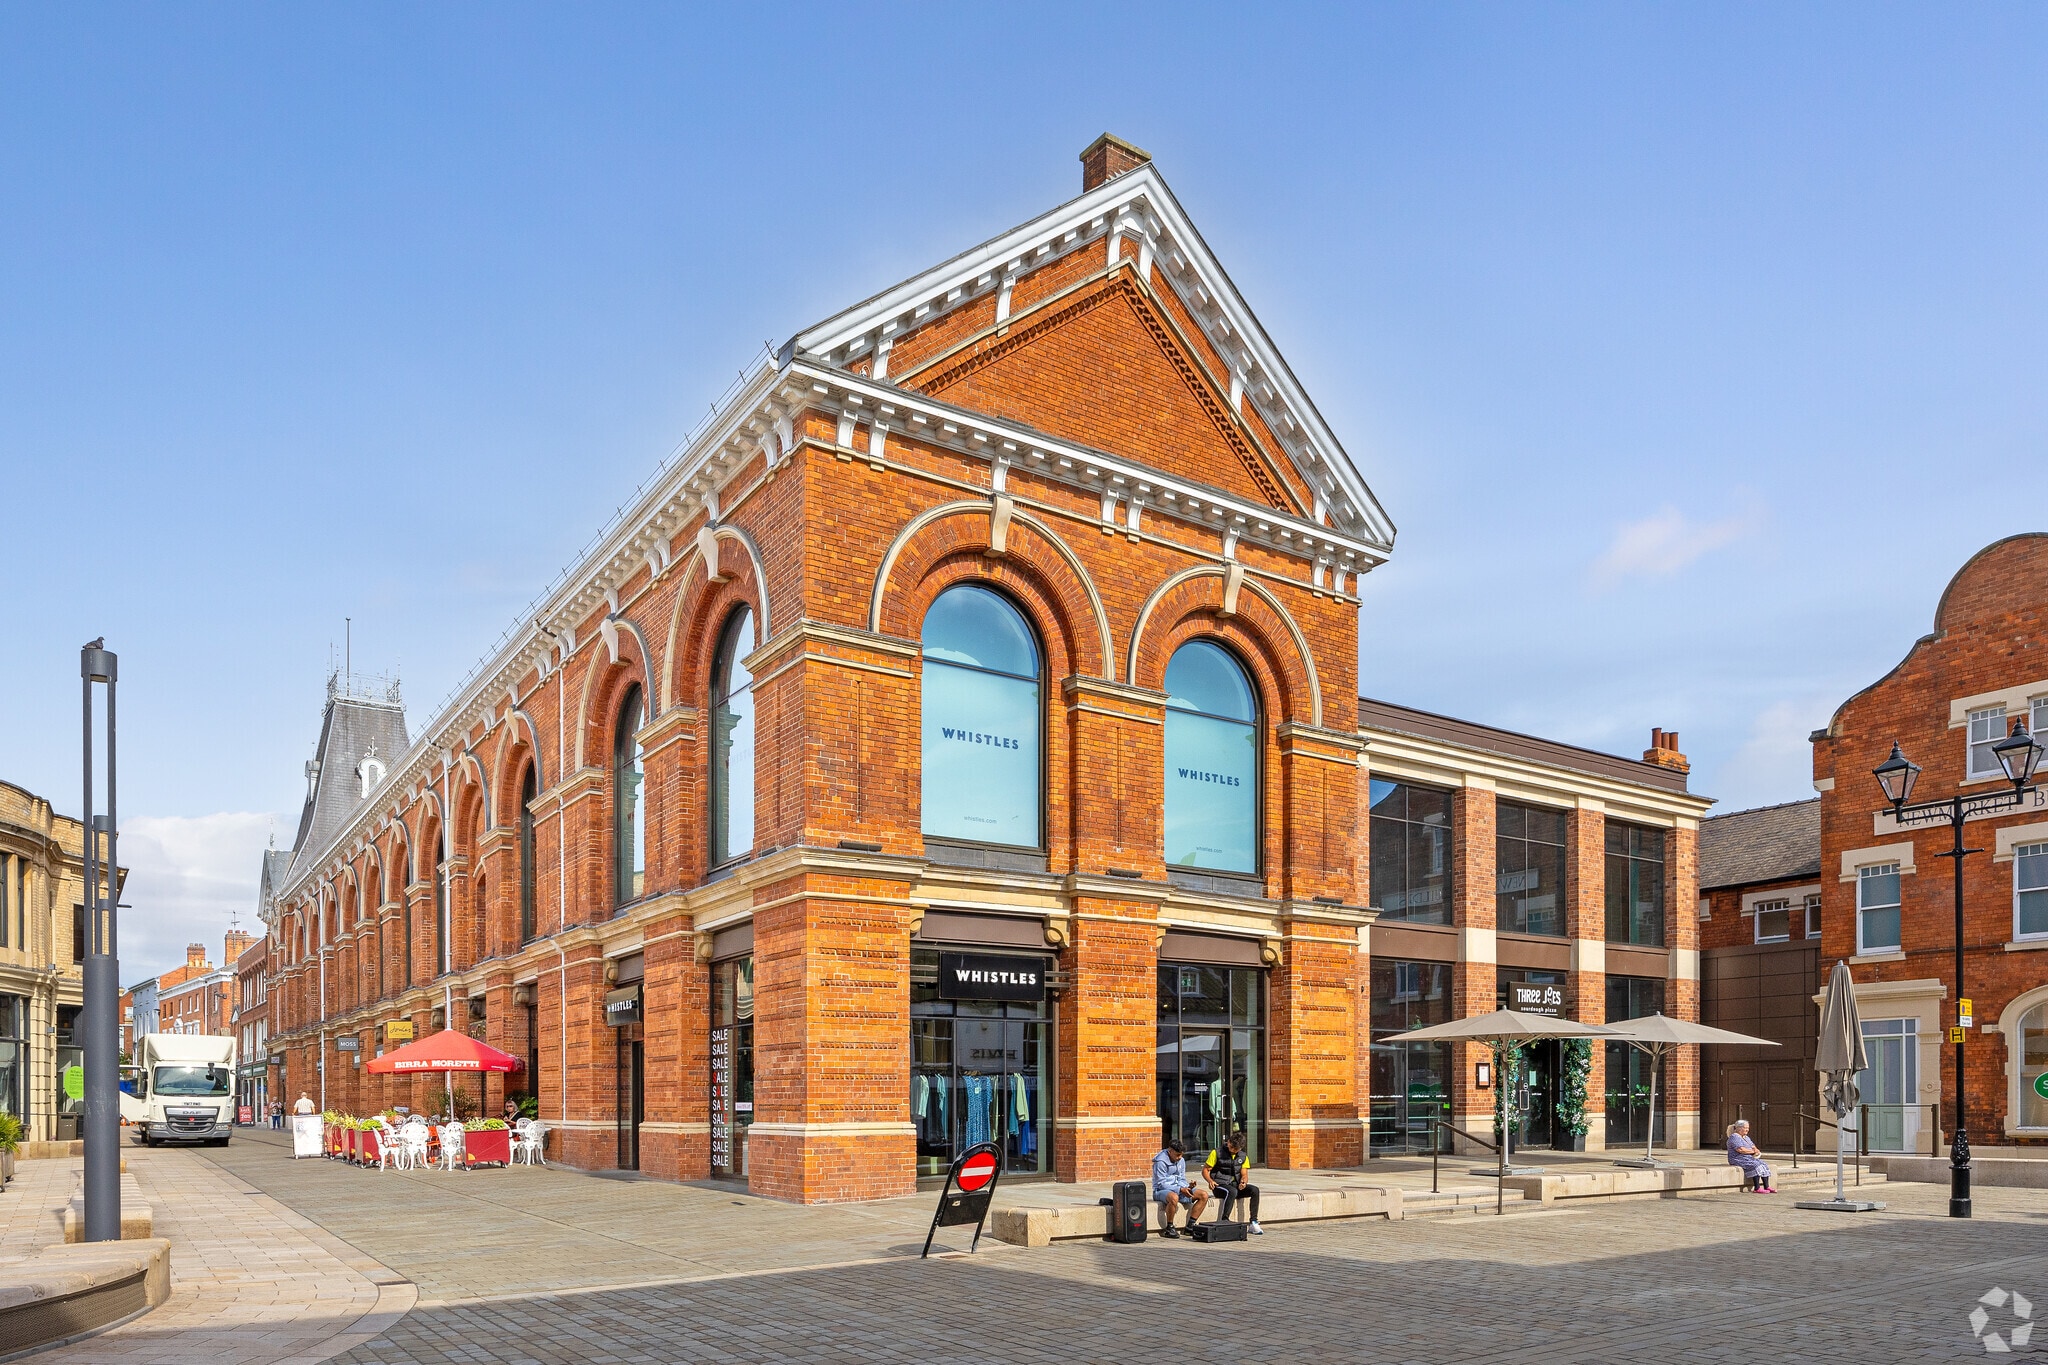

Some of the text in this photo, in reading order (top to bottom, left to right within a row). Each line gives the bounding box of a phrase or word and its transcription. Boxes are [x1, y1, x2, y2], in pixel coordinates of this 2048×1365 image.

[942, 727, 1019, 750] WHISTLES
[1178, 768, 1240, 787] WHISTLES
[1899, 795, 2014, 828] NEWMRKET
[963, 816, 997, 824] whistles.com
[956, 969, 1037, 985] WHISTLES
[712, 1029, 728, 1042] SALE
[712, 1043, 728, 1056] SALE
[395, 1061, 428, 1069] BIRRA
[431, 1059, 480, 1068] MORETTI
[712, 1058, 728, 1070] SALE
[712, 1072, 728, 1084] SALE
[712, 1085, 728, 1097] SALE
[712, 1099, 728, 1111] SALE
[712, 1113, 728, 1125] SALE
[712, 1127, 728, 1139] SALE
[712, 1141, 728, 1152] SALE
[712, 1155, 728, 1167] SALE
